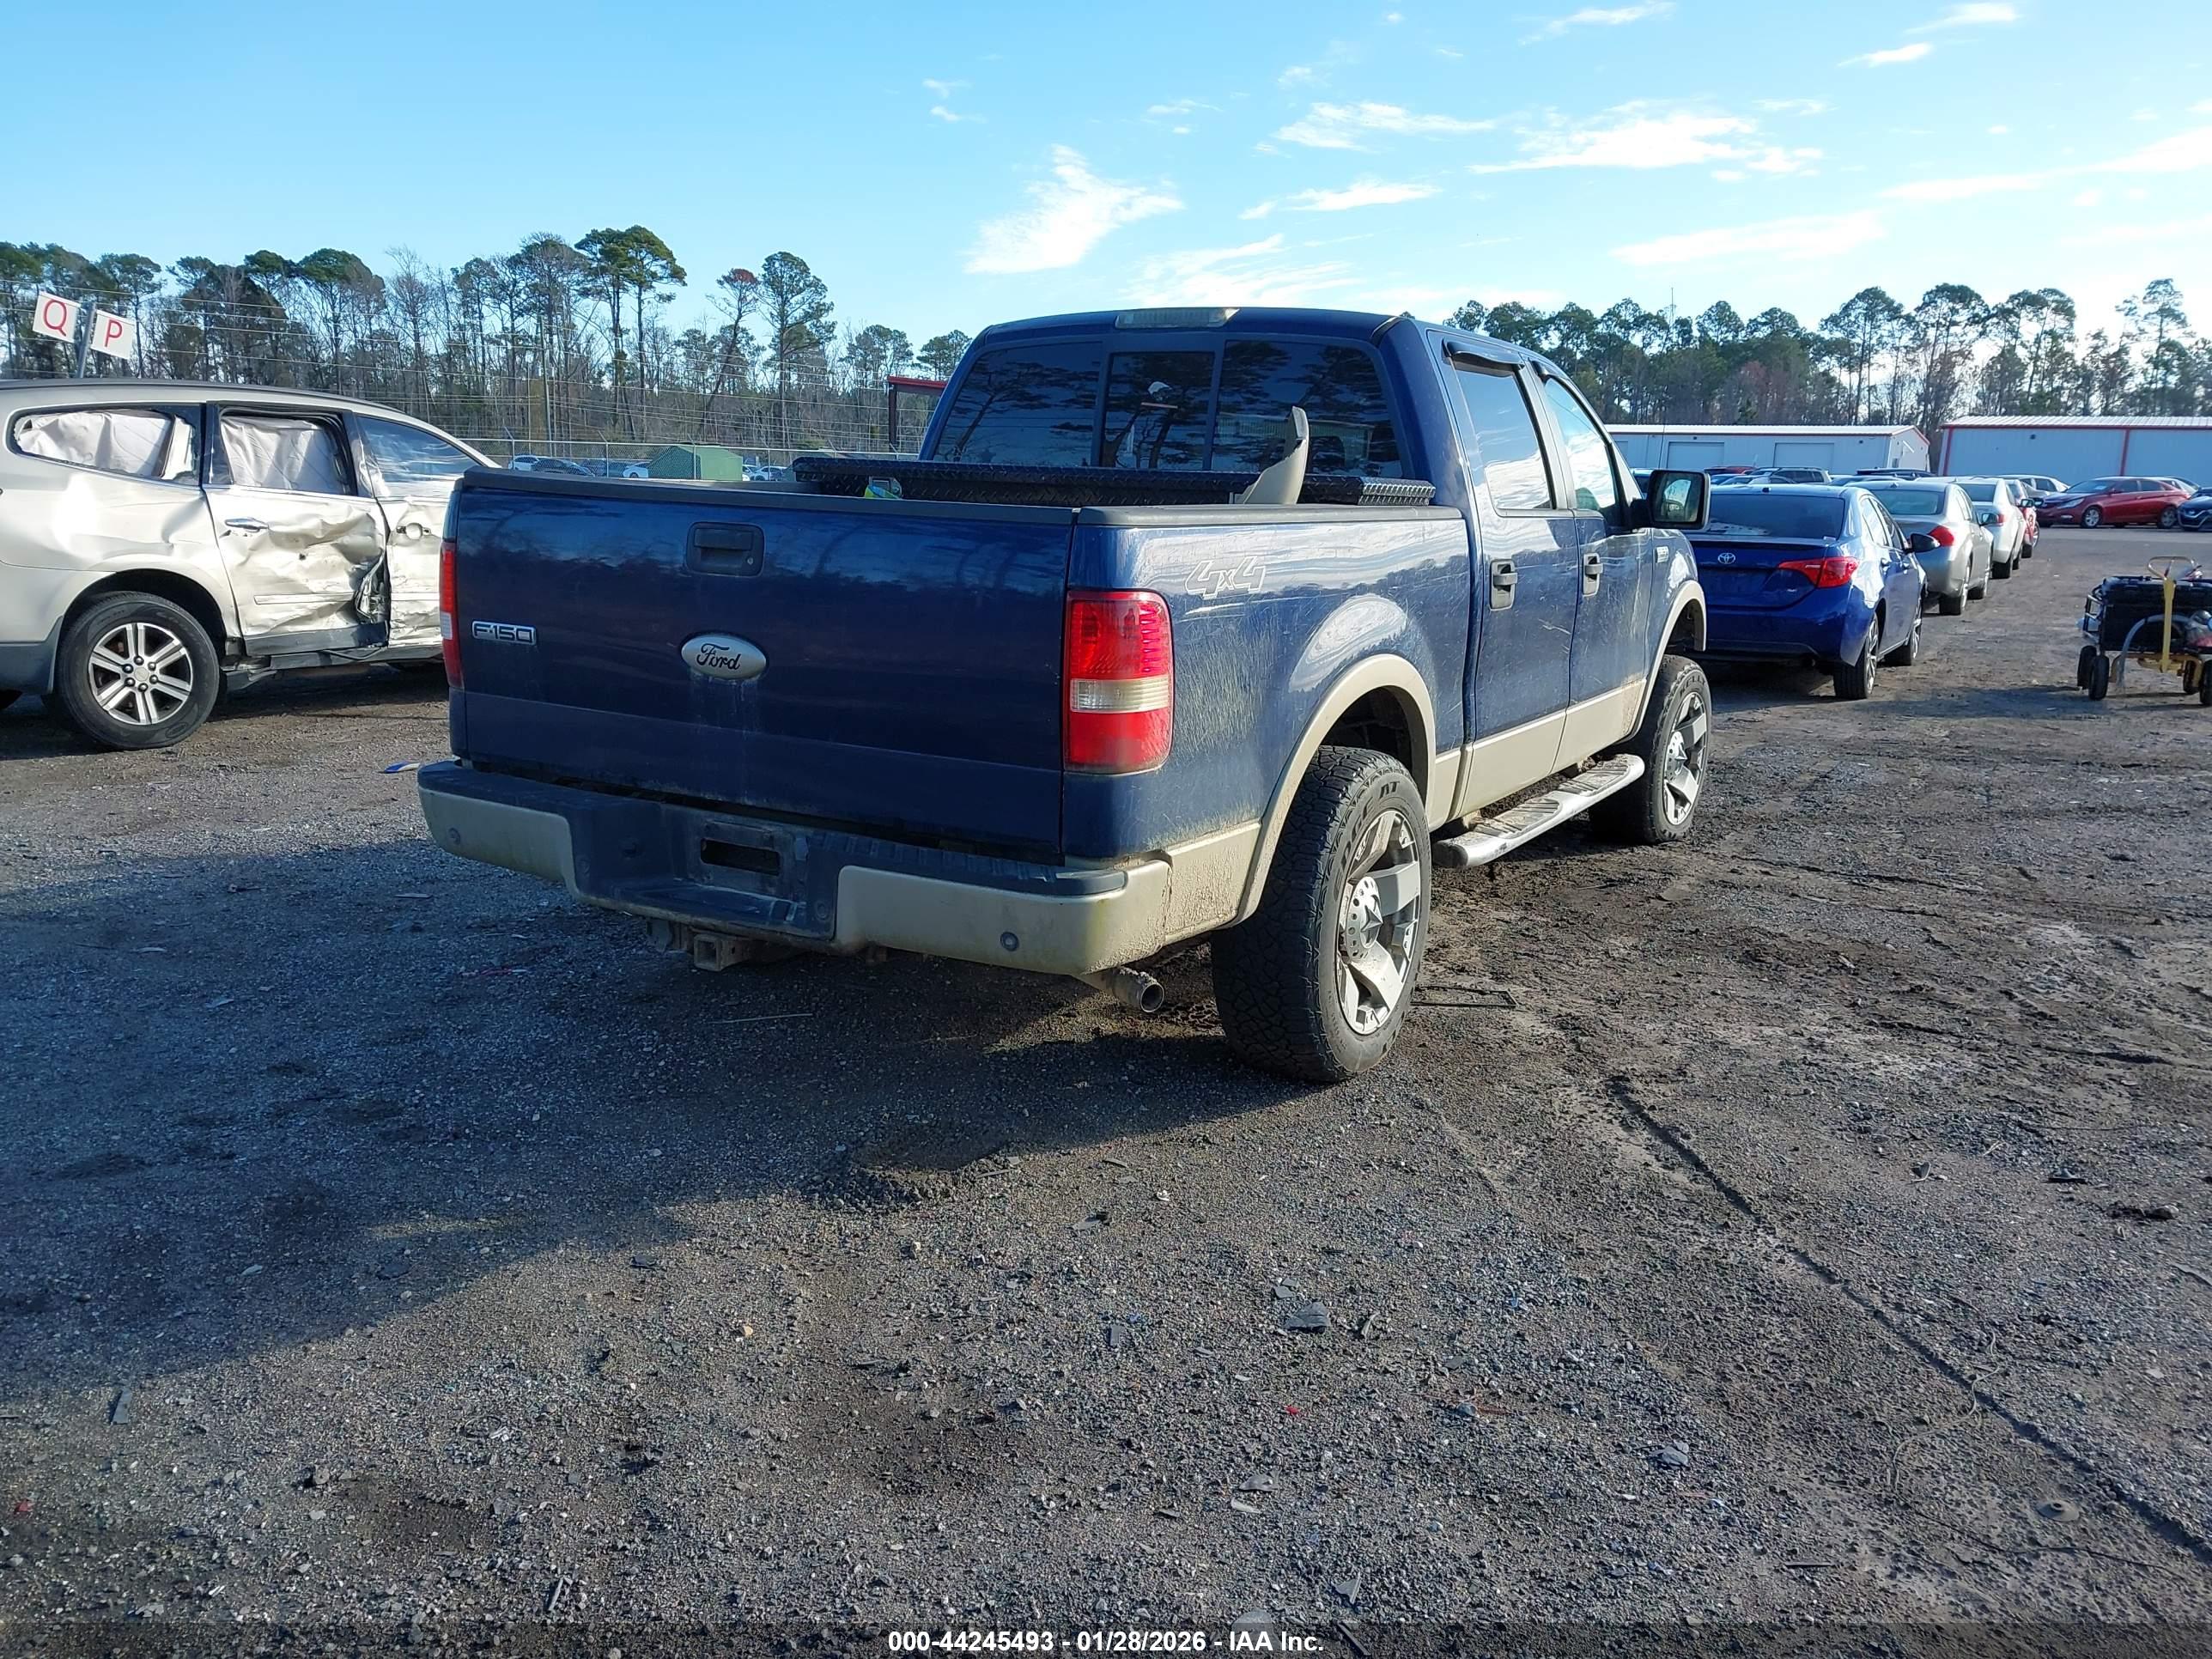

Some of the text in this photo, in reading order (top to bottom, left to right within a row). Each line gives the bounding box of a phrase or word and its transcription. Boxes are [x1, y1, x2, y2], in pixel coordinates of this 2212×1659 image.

[43, 299, 67, 337] Q
[104, 319, 123, 348] P
[1184, 556, 1267, 599] 4x4
[696, 642, 741, 670] Ford
